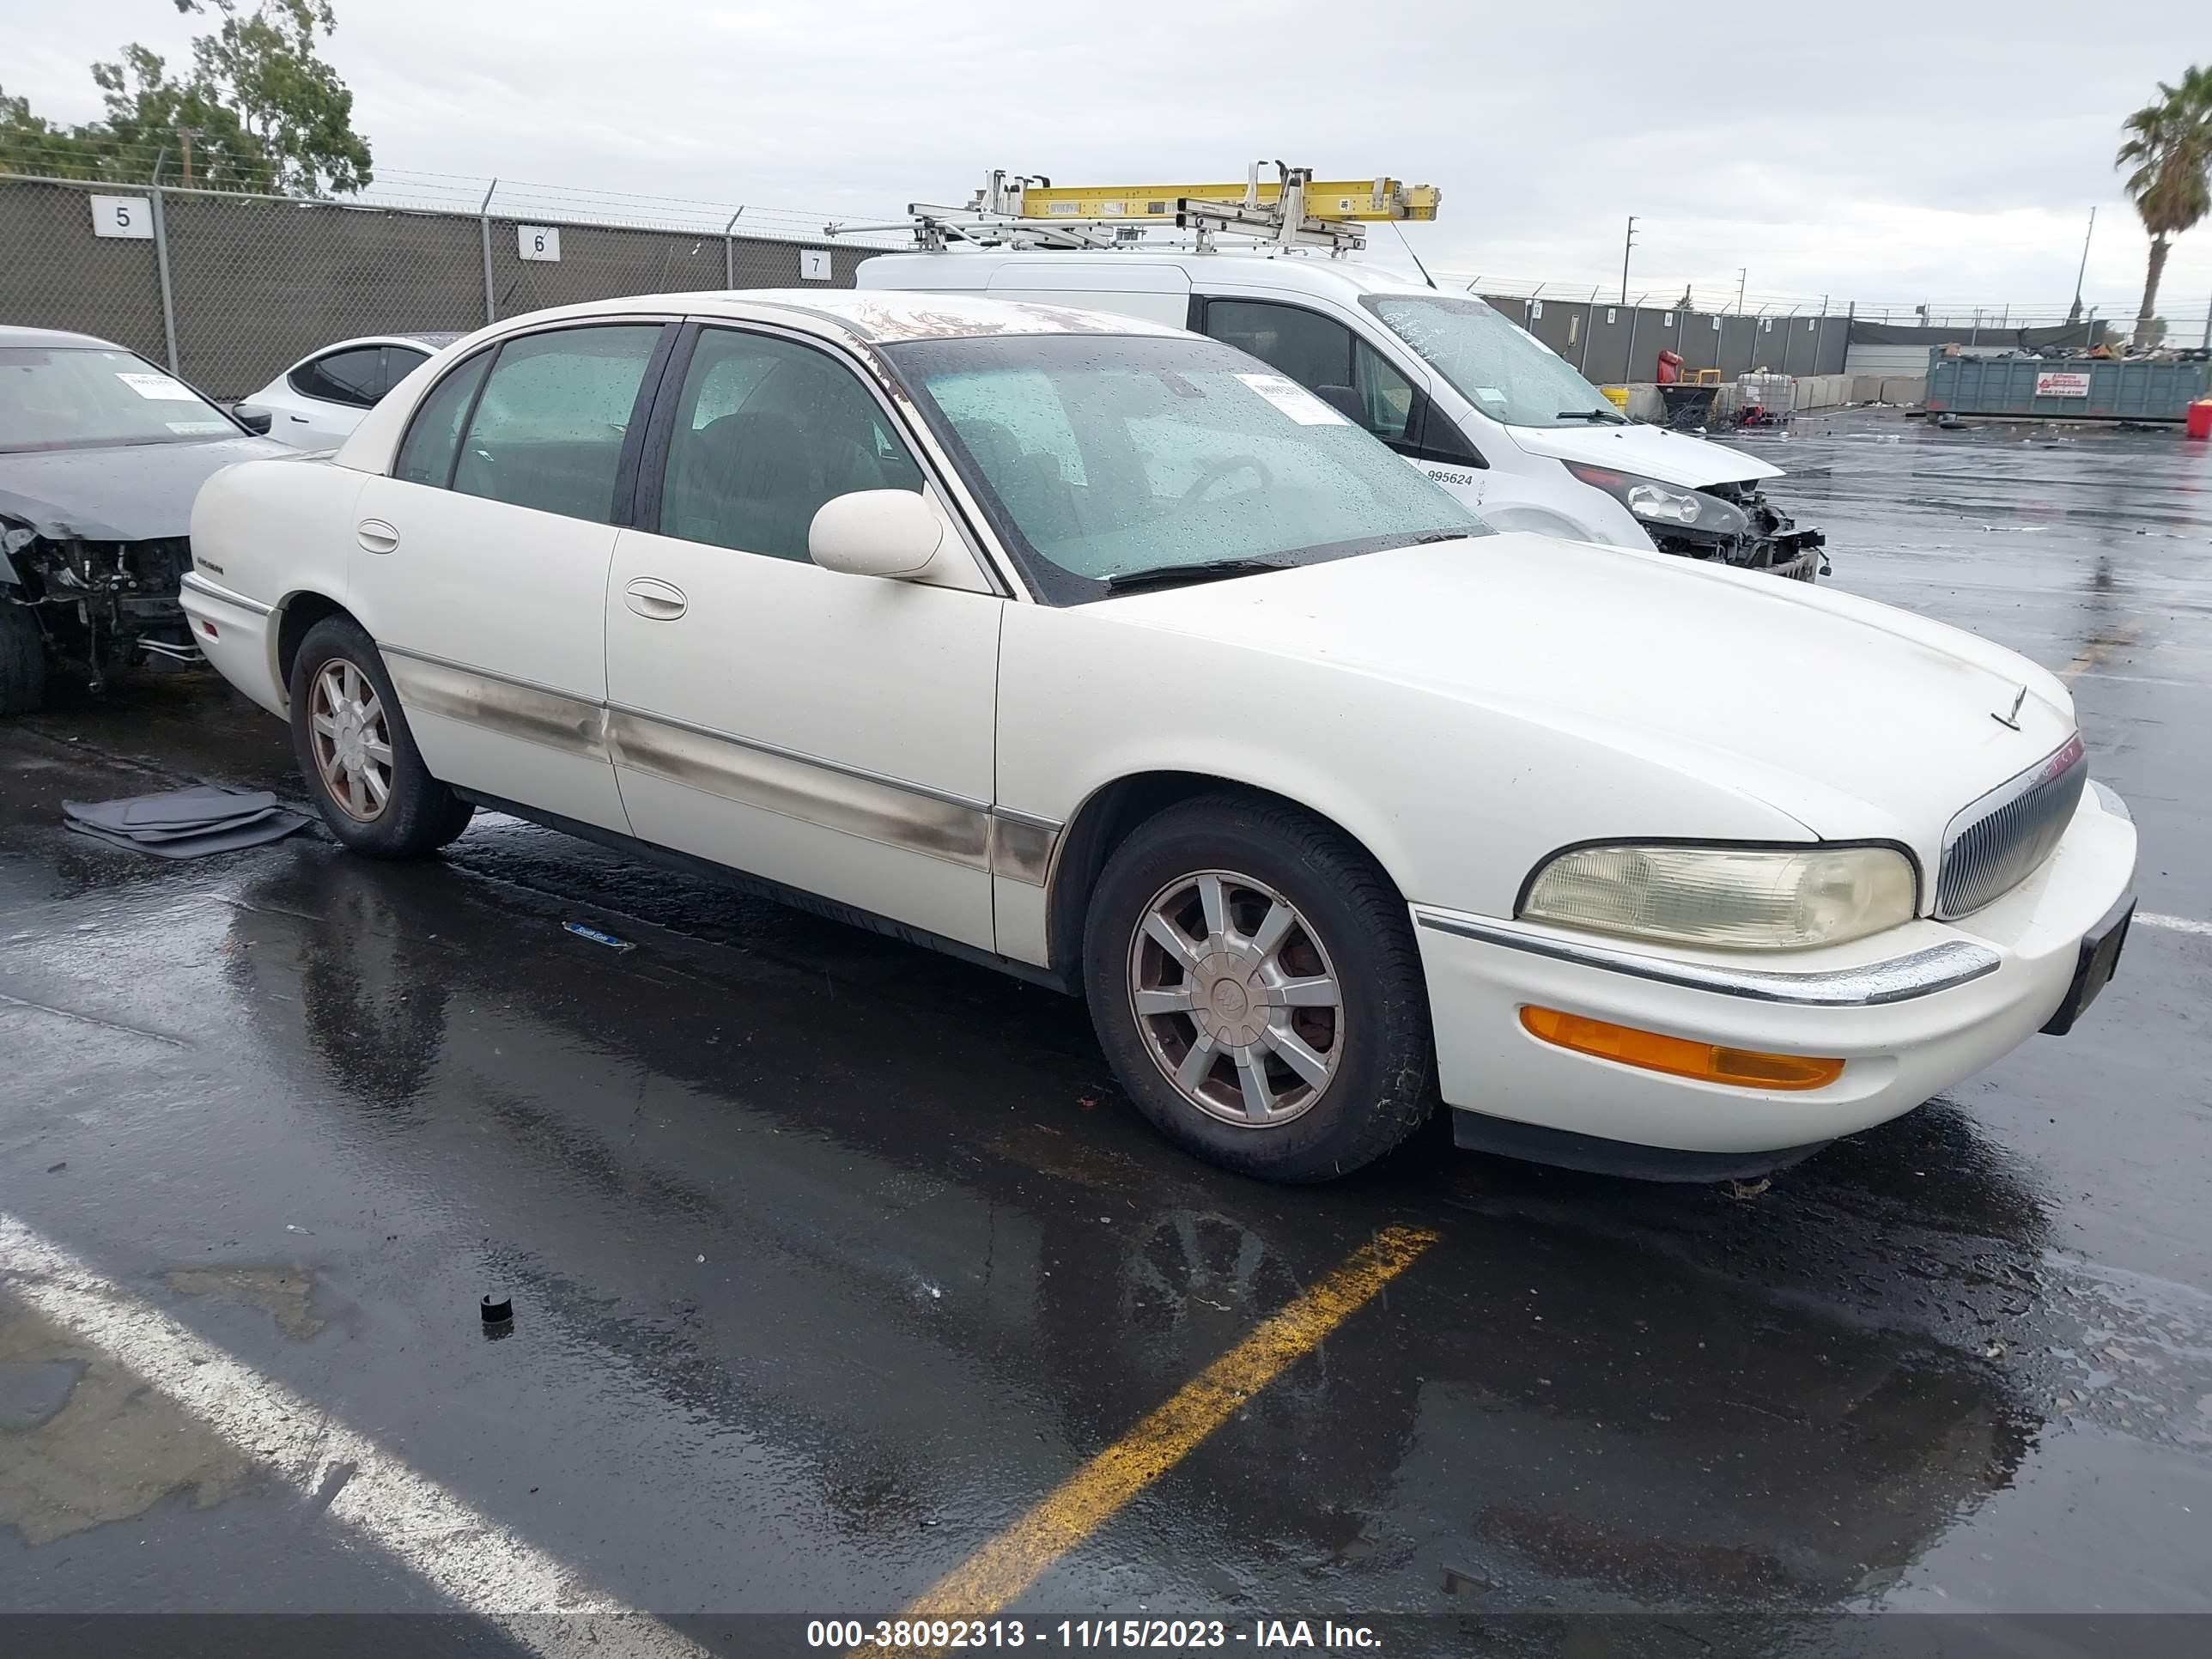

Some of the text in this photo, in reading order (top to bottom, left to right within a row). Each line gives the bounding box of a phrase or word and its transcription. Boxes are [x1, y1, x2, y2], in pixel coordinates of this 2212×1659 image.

[117, 207, 130, 228] 5
[535, 235, 544, 252] 6
[812, 258, 820, 272] 7
[1428, 470, 1473, 485] 995624
